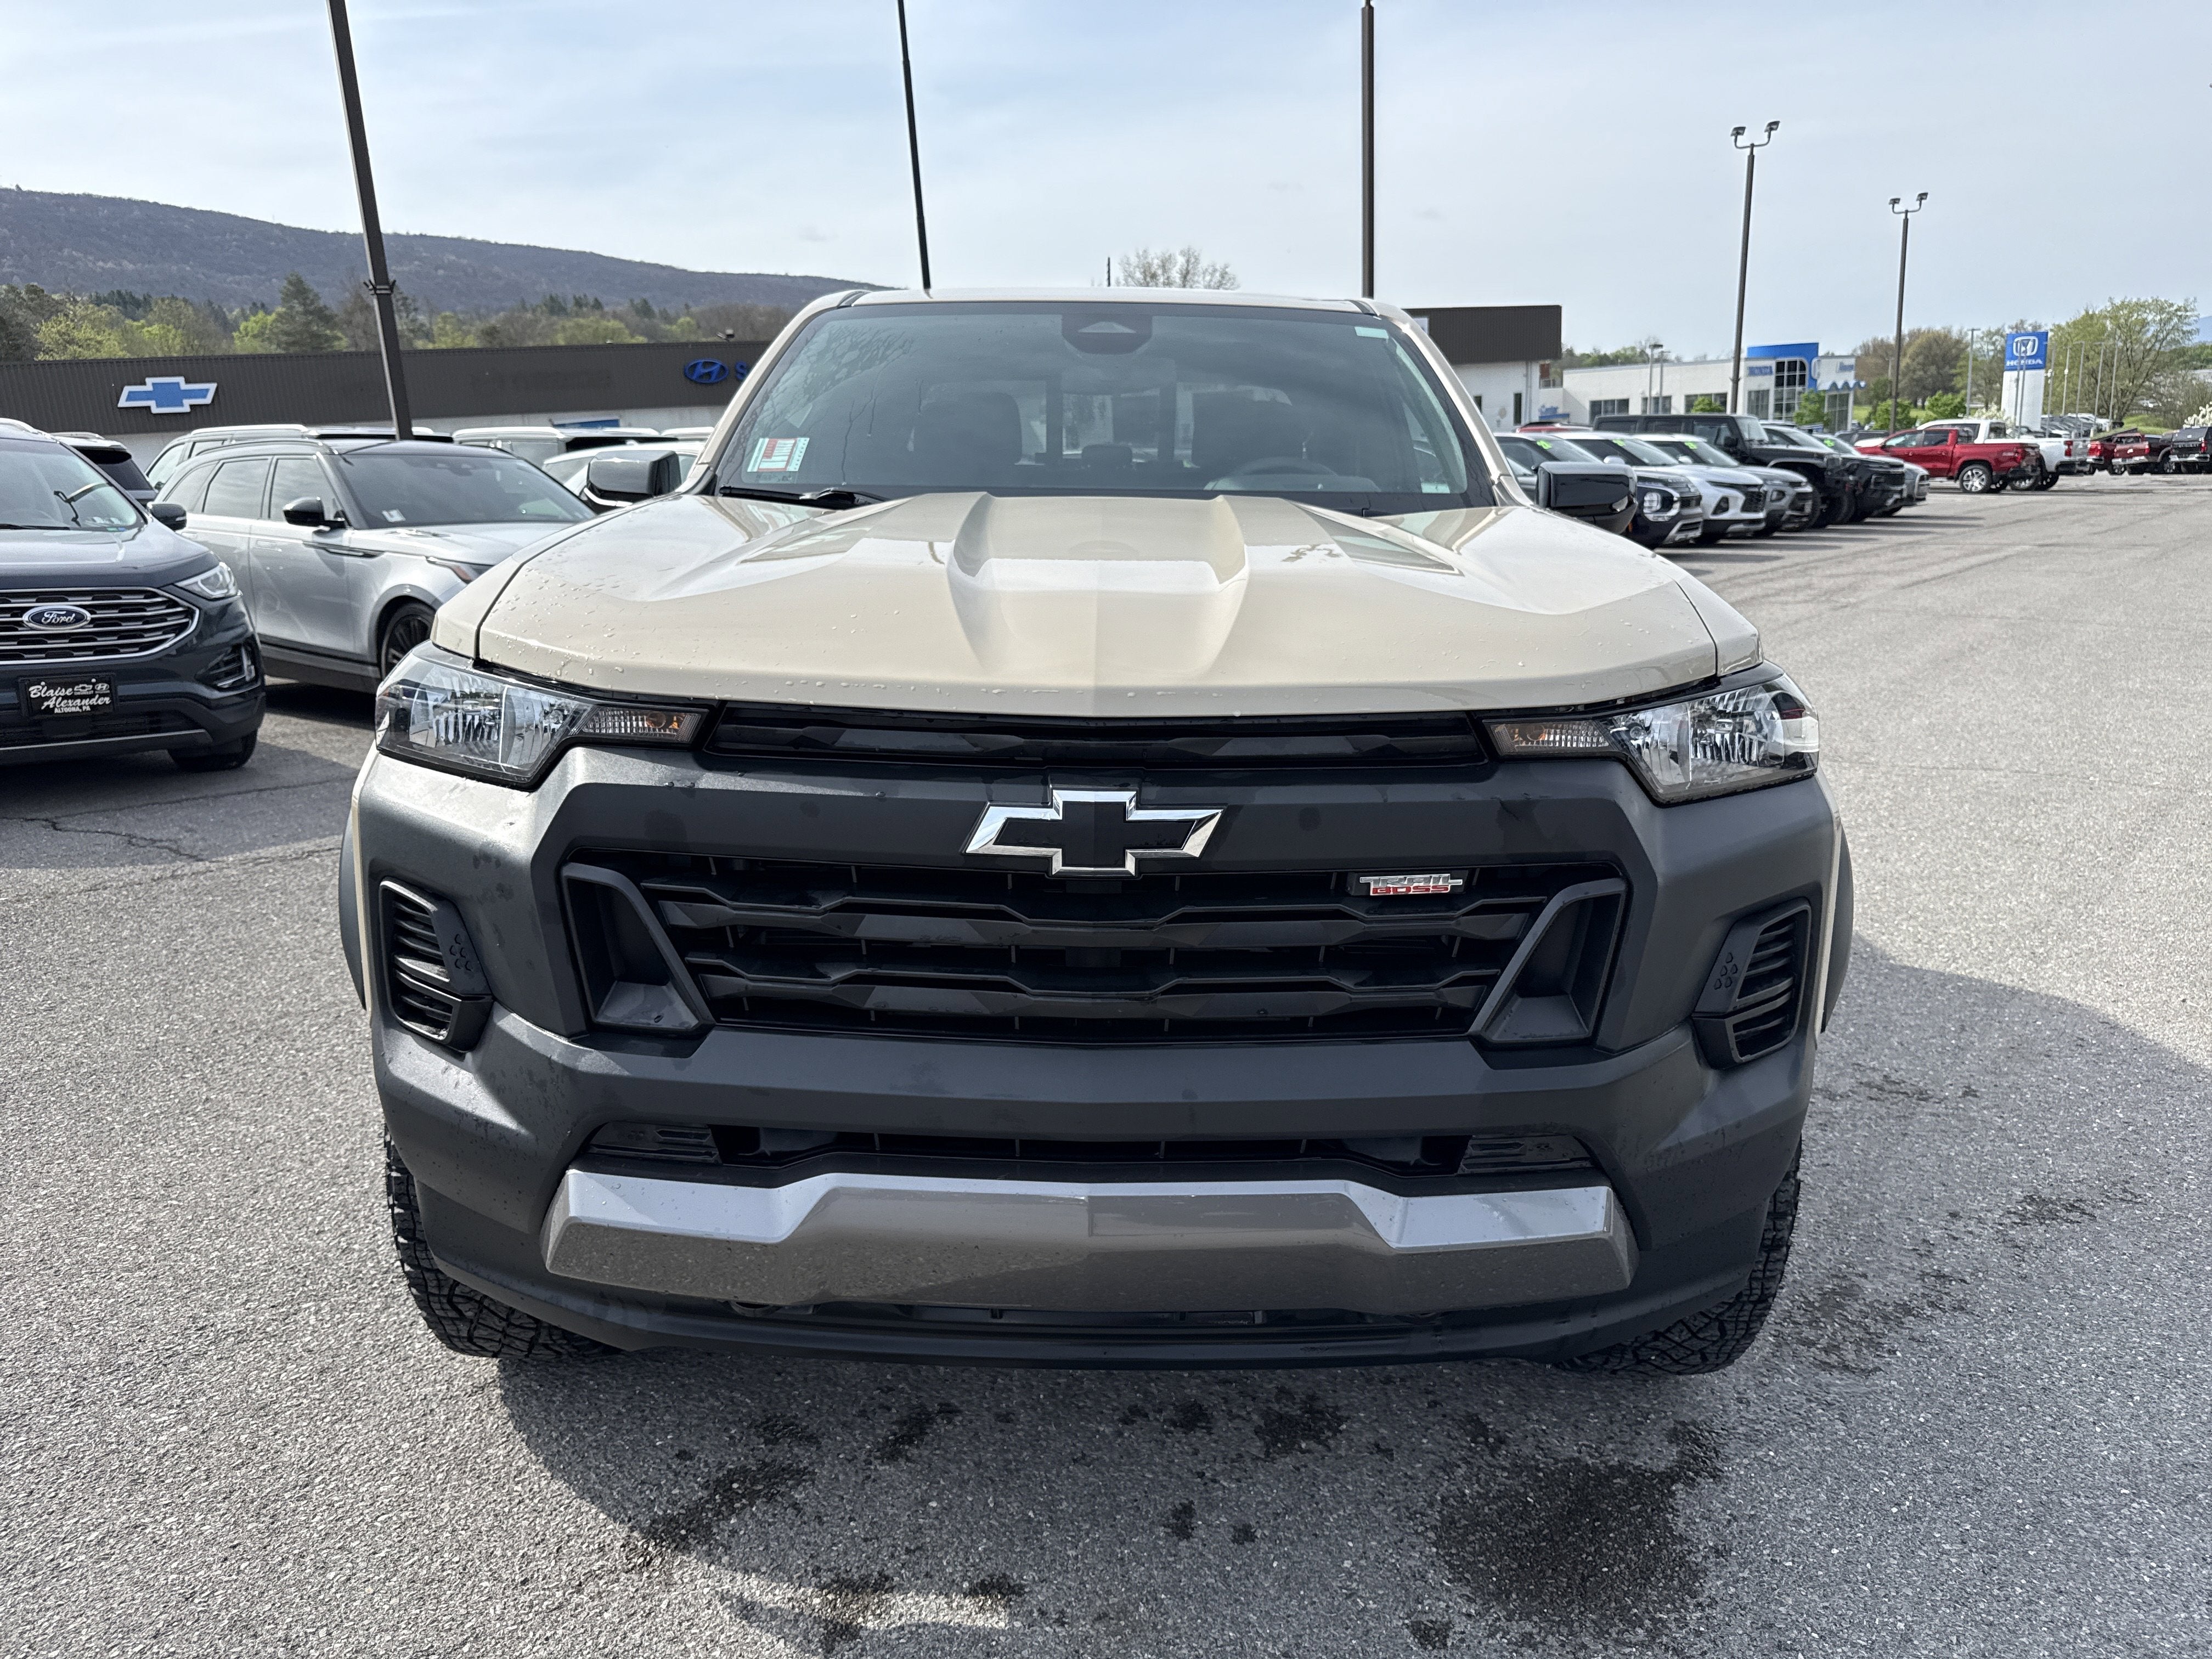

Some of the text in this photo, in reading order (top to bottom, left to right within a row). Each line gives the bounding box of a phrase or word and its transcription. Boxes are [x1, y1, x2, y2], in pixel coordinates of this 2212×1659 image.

[41, 611, 76, 624] Ford
[29, 685, 74, 698] Blaise
[41, 694, 111, 709] Alexander
[1359, 874, 1463, 887] TRAIL
[1371, 885, 1450, 895] BOSS
